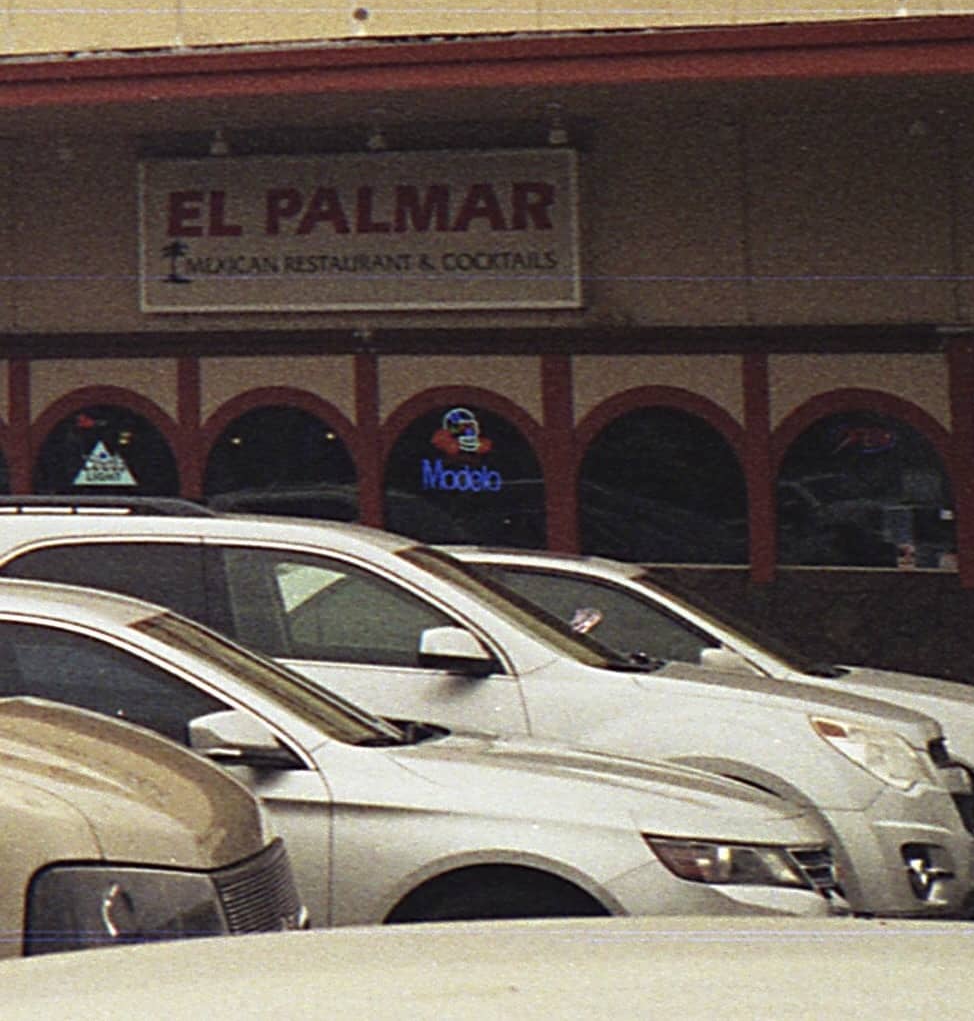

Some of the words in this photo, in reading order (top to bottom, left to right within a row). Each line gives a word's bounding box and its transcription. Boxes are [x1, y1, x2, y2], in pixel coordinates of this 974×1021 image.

[167, 190, 243, 237] EL
[266, 182, 556, 236] PALMAR
[187, 255, 280, 275] MEXICAN
[284, 253, 411, 273] RESTAURANT
[417, 254, 435, 271] &
[441, 251, 558, 271] COCKTAILS
[421, 458, 502, 492] Modelo
